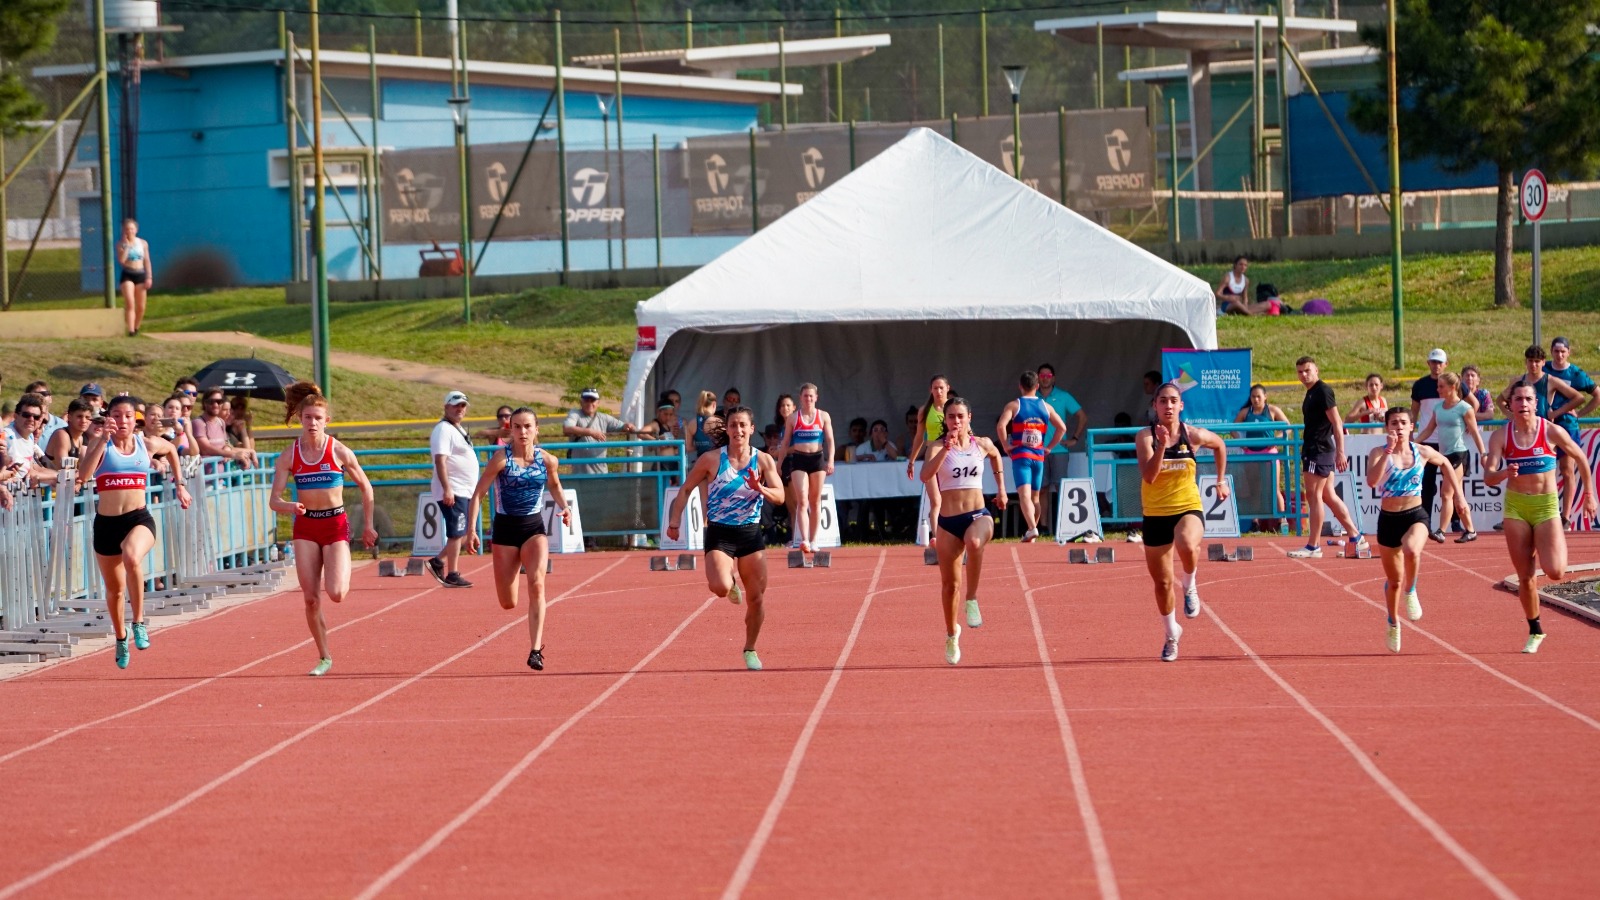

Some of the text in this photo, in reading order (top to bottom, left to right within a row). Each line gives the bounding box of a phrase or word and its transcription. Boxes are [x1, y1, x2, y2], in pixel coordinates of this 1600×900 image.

[1526, 184, 1542, 207] 30
[105, 478, 145, 487] SANTA FE
[952, 466, 978, 479] 314
[1169, 462, 1187, 471] LUIS
[309, 510, 333, 518] NIKE
[544, 500, 556, 536] 7
[690, 496, 699, 533] 6
[820, 493, 832, 530] 5
[1067, 487, 1088, 525] 3
[1205, 484, 1227, 521] 2
[422, 502, 438, 540] 8
